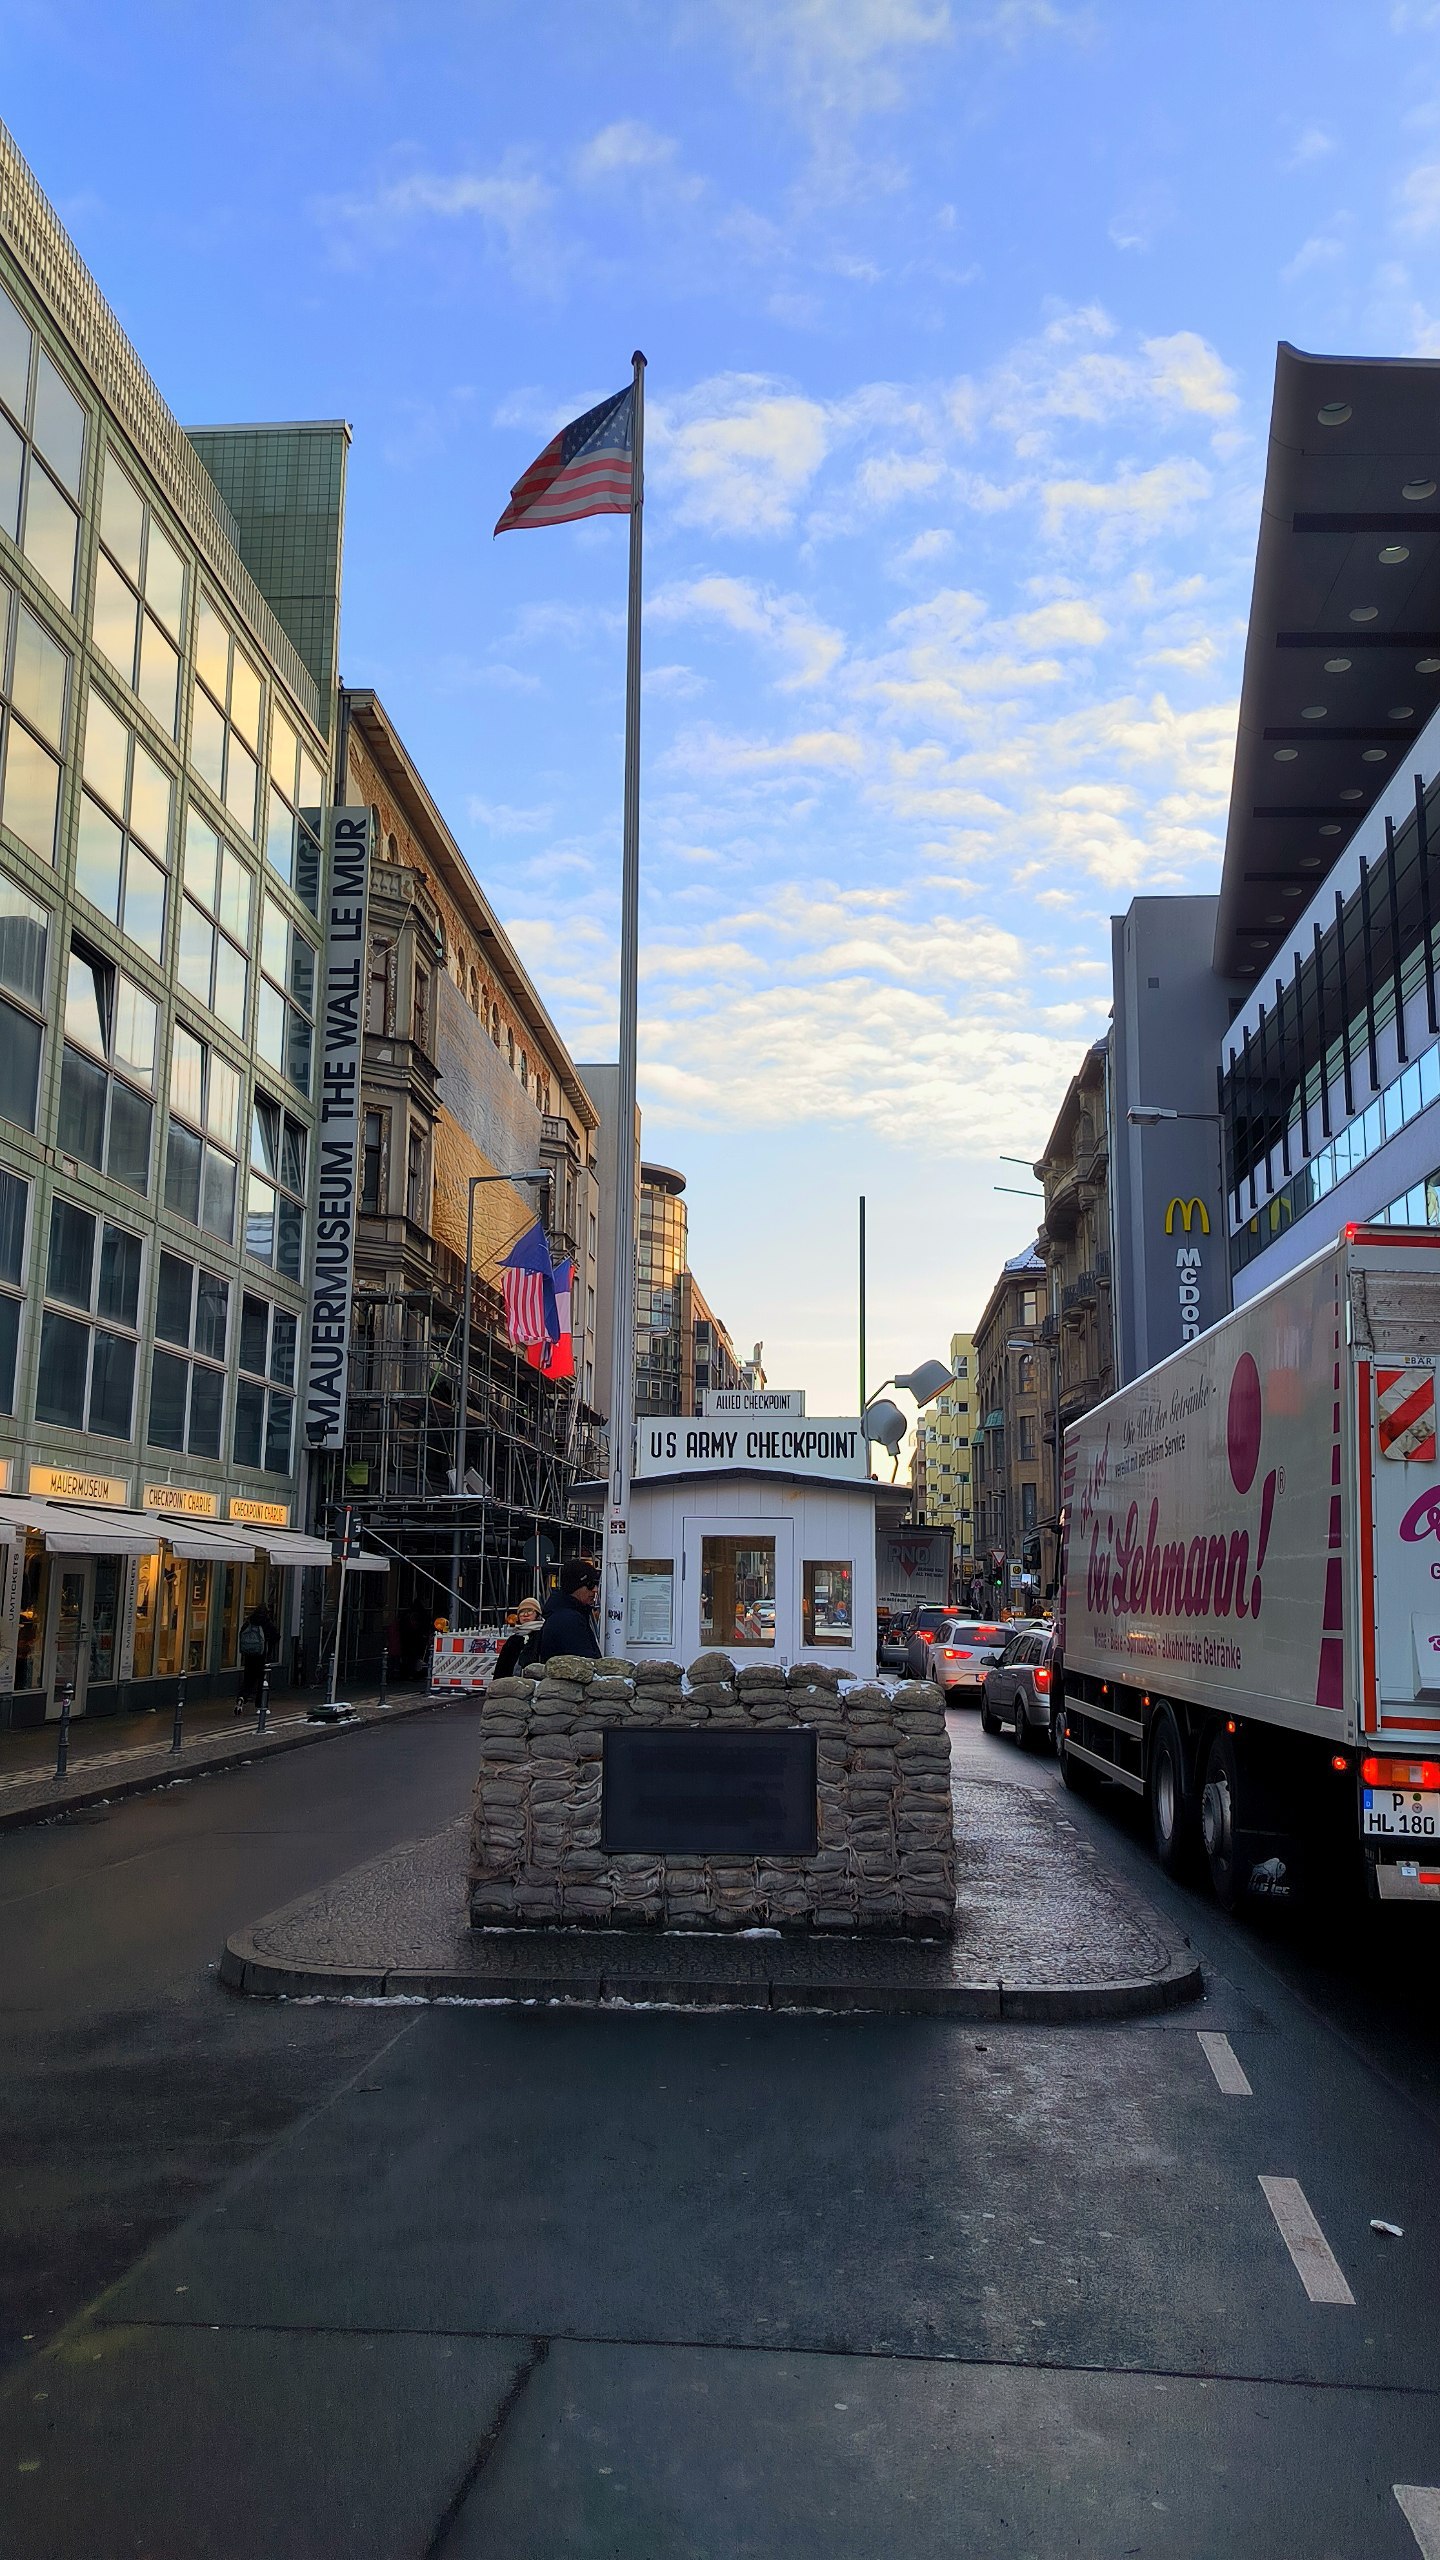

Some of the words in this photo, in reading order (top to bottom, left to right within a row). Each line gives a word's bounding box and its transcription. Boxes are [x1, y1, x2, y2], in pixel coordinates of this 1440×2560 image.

[332, 818, 367, 897] MUR
[330, 907, 363, 942] LE
[325, 958, 361, 1052] WALL
[321, 1062, 356, 1123] THE
[307, 1141, 354, 1435] MAUERMUSEUM
[716, 1394, 741, 1410] ALLIED
[743, 1394, 791, 1410] CHECKPOINT
[1154, 1400, 1168, 1433] der
[686, 1431, 738, 1459] ARMY
[746, 1431, 858, 1459] CHECKPOINT
[1164, 1432, 1186, 1458] Service
[50, 1474, 110, 1499] MAUERMUSEUM
[149, 1488, 187, 1508] CHECKPOINT
[188, 1494, 212, 1513] CHARLIE
[233, 1501, 264, 1520] CHECKPOINT
[264, 1506, 284, 1523] CHARLIE
[1162, 1632, 1202, 1664] alkoholfreie
[1203, 1636, 1241, 1669] Getränke
[1392, 1793, 1404, 1812] P
[1369, 1813, 1394, 1832] HL
[1398, 1814, 1436, 1834] 180
